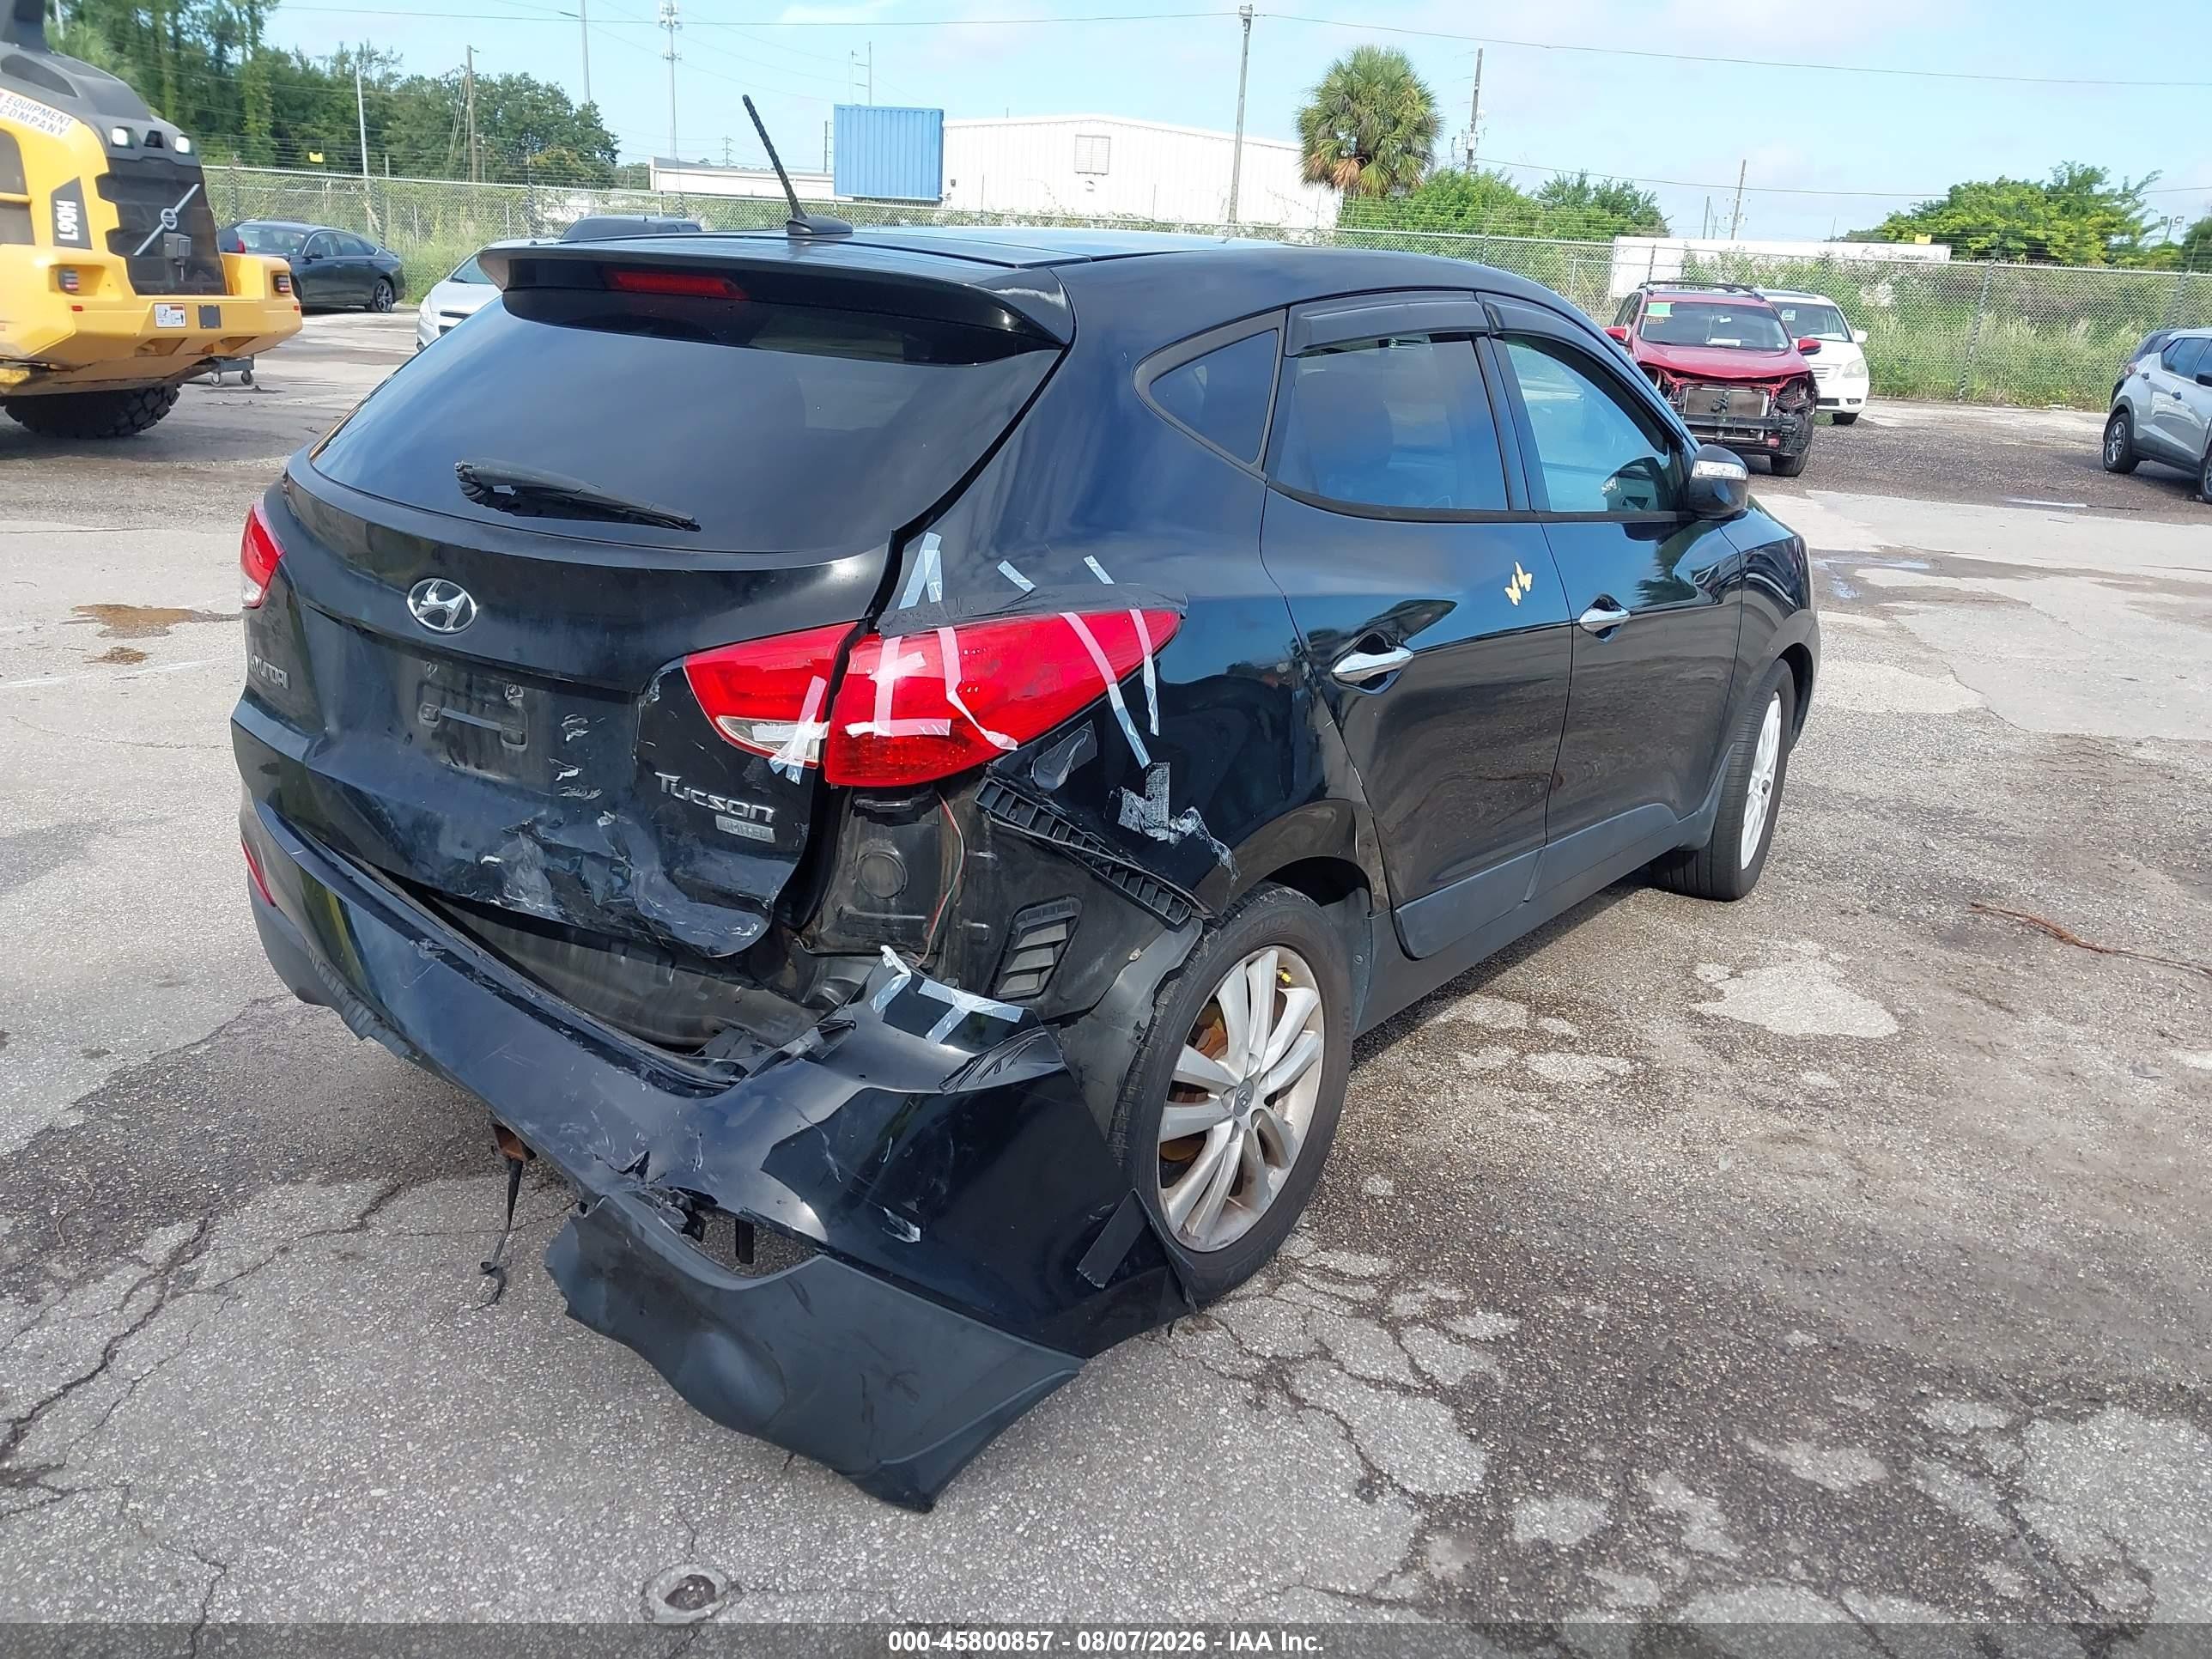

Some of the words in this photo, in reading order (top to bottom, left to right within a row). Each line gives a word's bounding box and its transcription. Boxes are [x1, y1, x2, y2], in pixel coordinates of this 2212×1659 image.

[0, 105, 66, 136] COMPANY
[6, 95, 74, 126] EQUIPMENT
[55, 199, 79, 241] L90H
